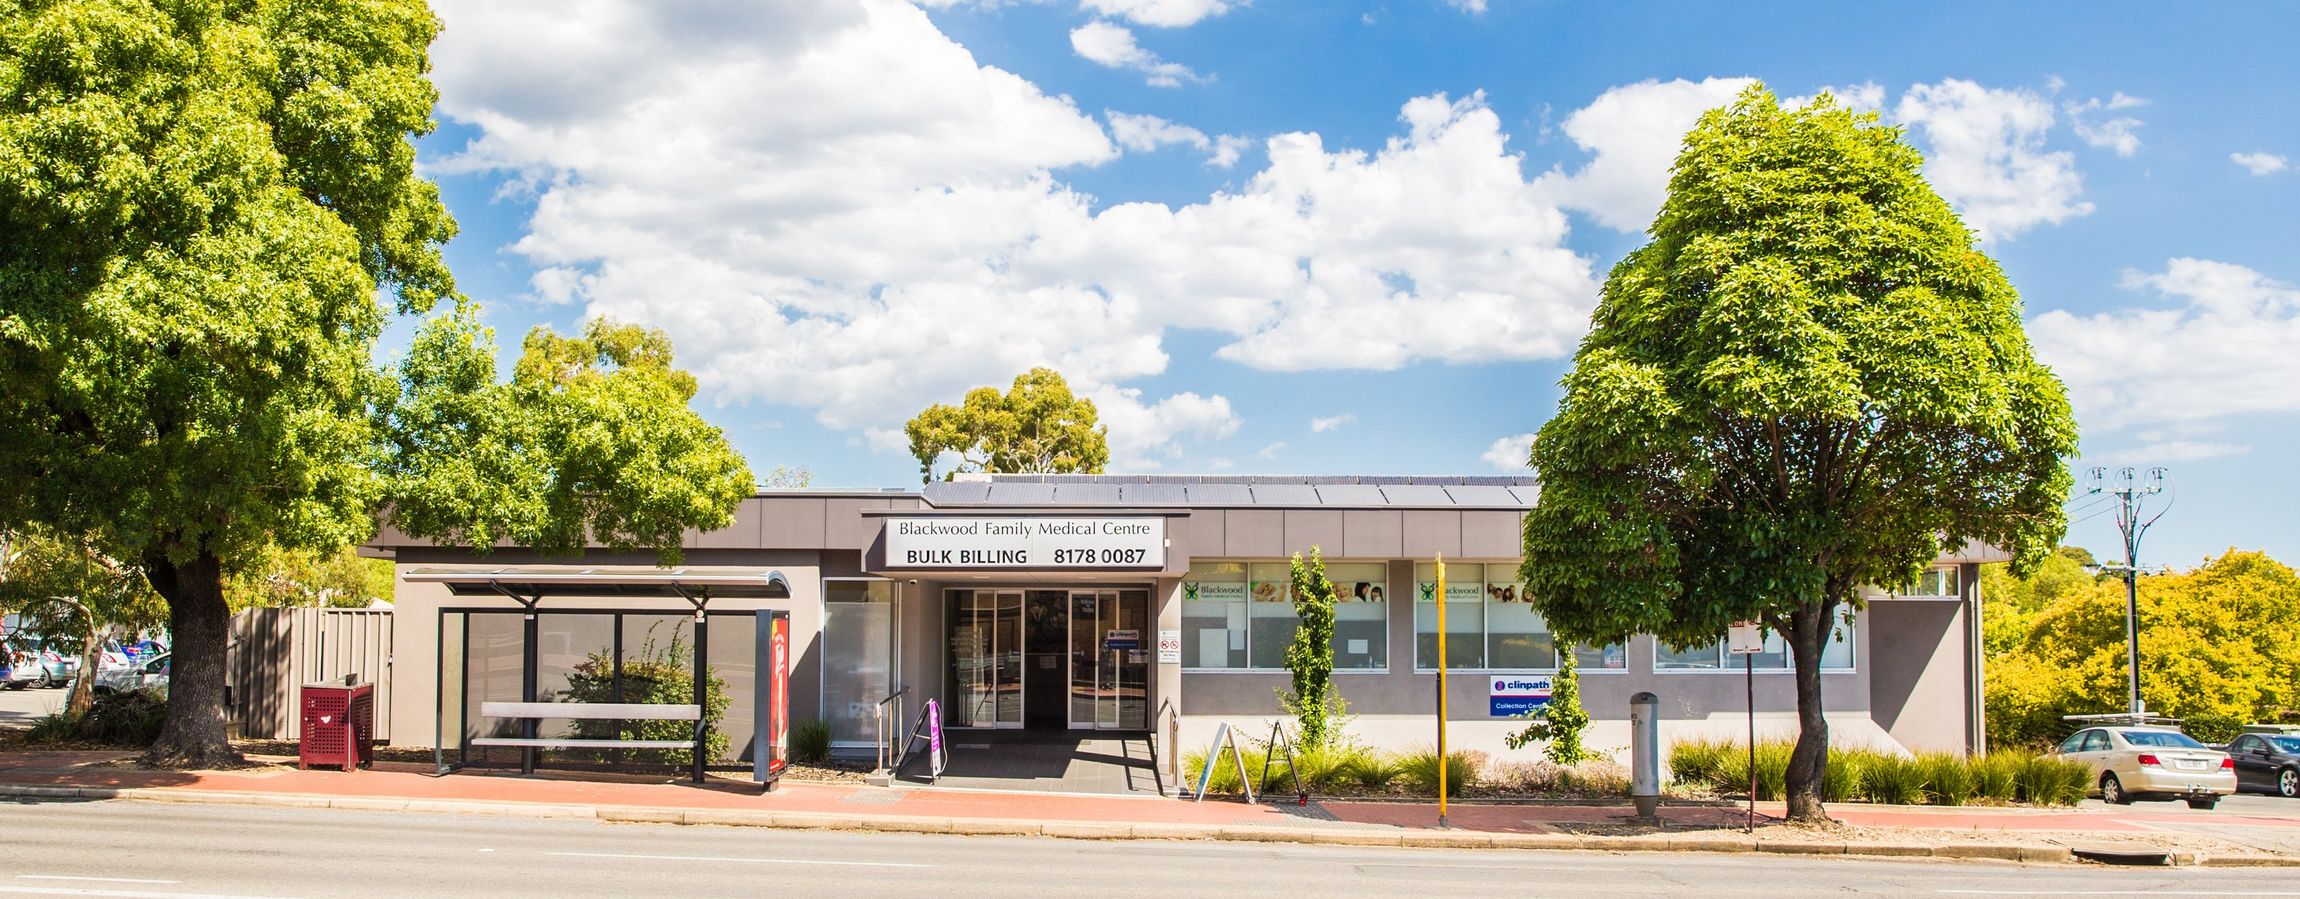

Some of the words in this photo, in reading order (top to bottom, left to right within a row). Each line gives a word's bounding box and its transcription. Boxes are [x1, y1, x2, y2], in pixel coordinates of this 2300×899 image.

[899, 521, 978, 536] Blackwood
[985, 521, 1032, 539] Family
[1038, 521, 1096, 536] Medical
[1102, 521, 1151, 536] Centre
[906, 549, 952, 564] BULK
[960, 549, 1027, 564] BILLING
[1053, 549, 1096, 564] 8178
[1101, 549, 1146, 564] 0087
[1445, 586, 1479, 595] ackwood
[1507, 680, 1550, 690] clinpath
